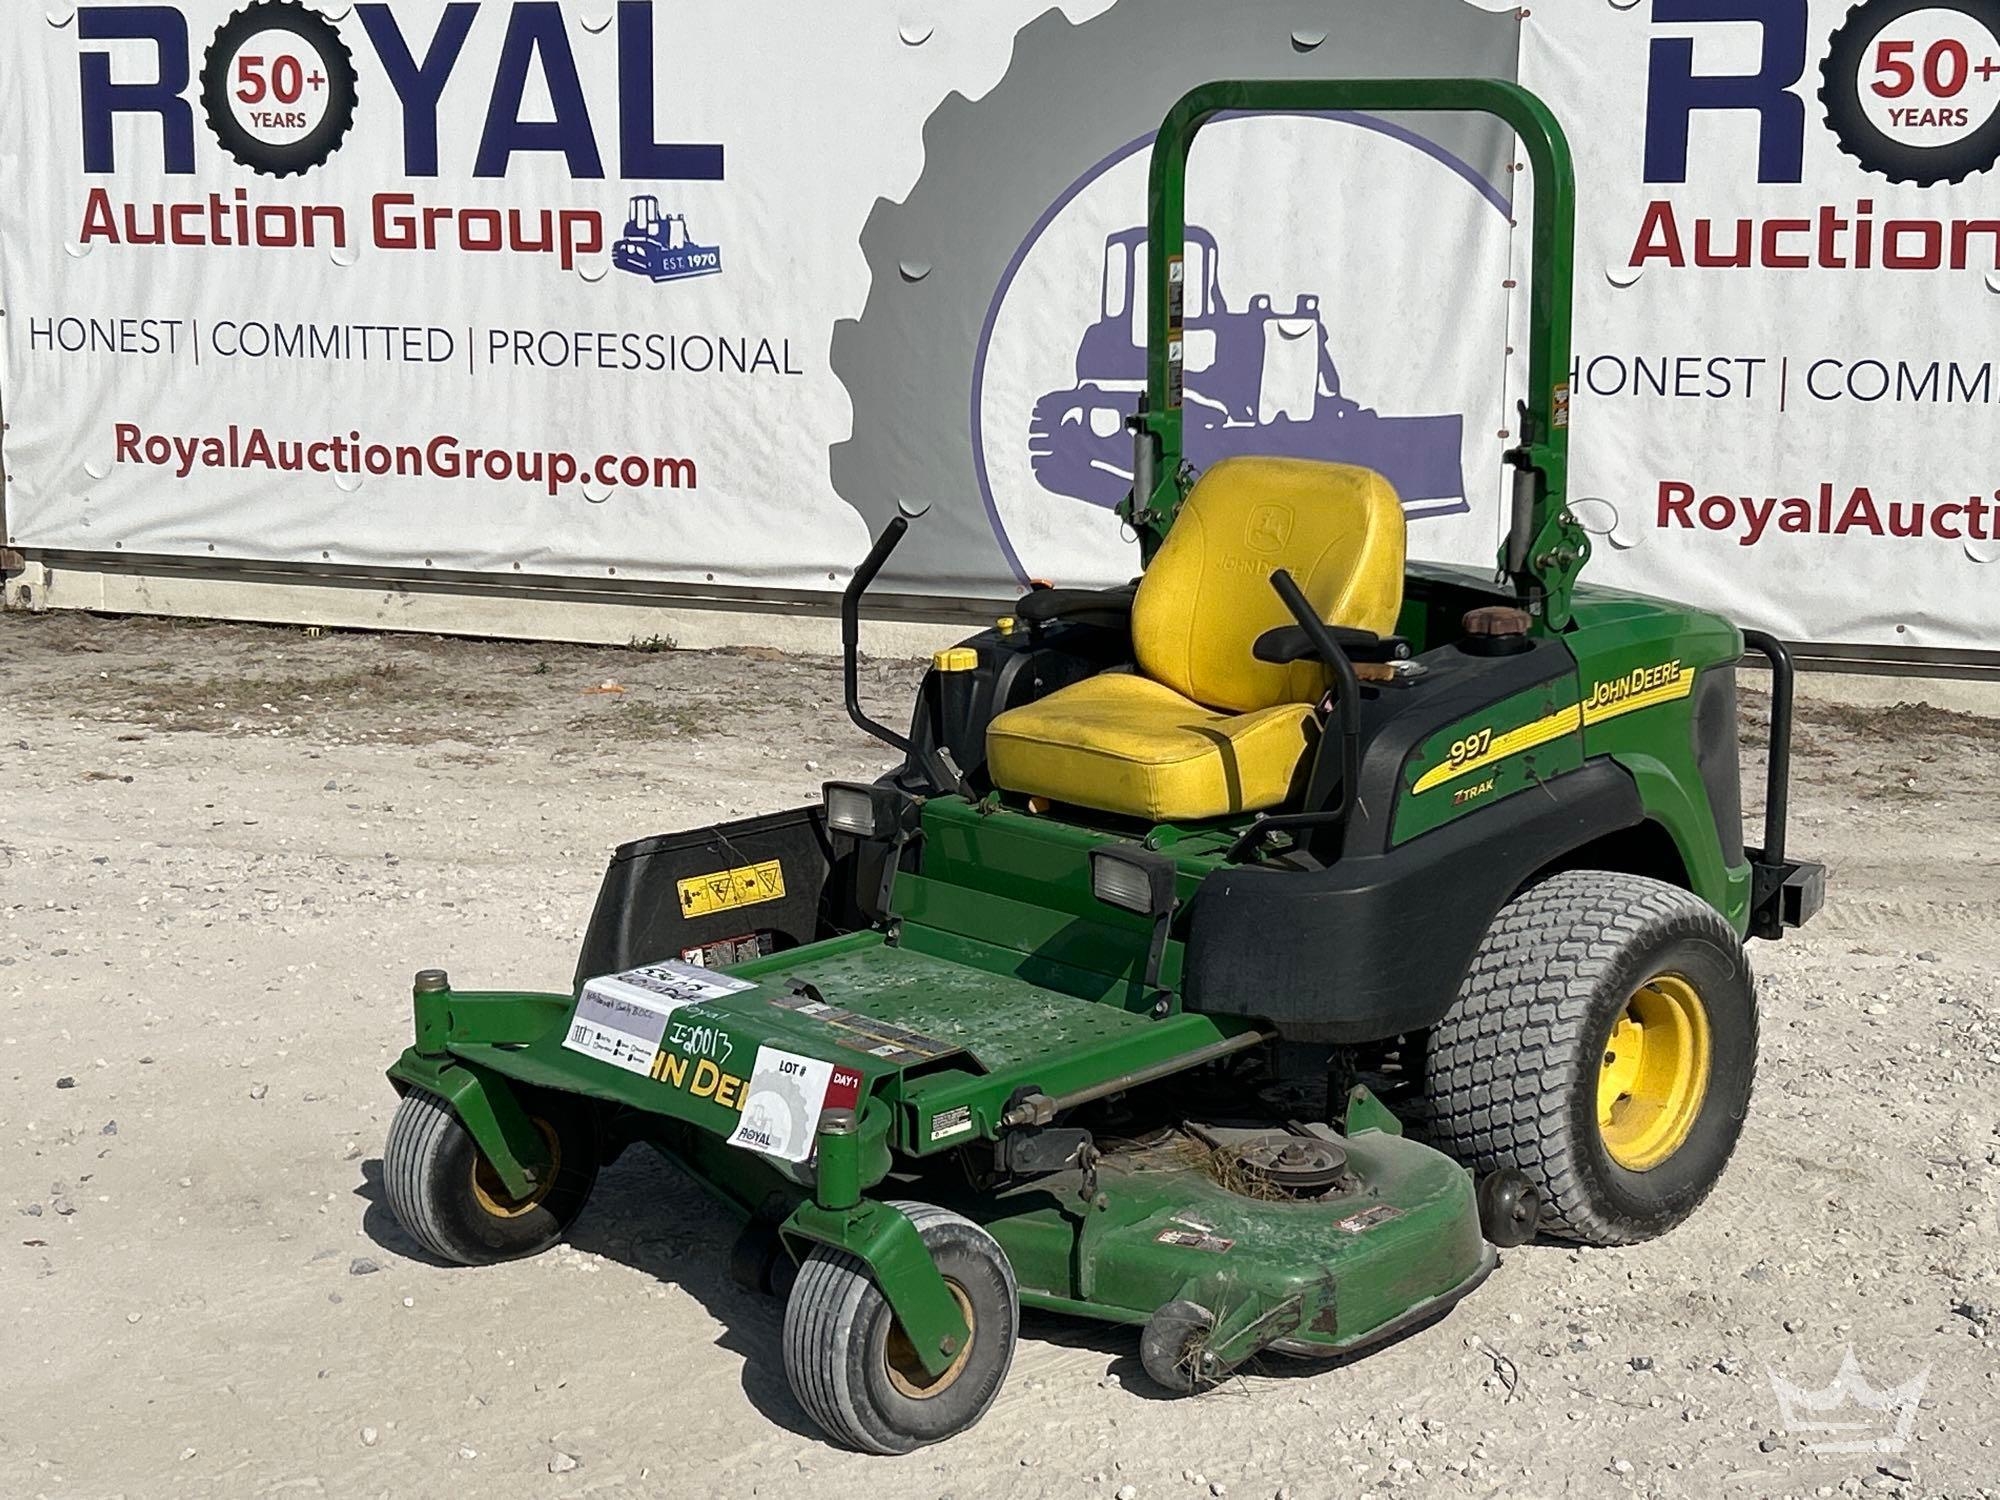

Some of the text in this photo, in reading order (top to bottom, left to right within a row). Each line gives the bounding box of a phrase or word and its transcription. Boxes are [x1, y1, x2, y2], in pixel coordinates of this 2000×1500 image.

[80, 1, 724, 181] ROYAL
[236, 54, 325, 104] 50+
[1870, 38, 2000, 99] 50+
[249, 111, 307, 129] YEARS
[1887, 108, 1969, 127] YEARS
[80, 187, 603, 269] Auction Group
[1629, 199, 2000, 270] Auction
[687, 252, 717, 268] 1970
[29, 316, 804, 375] HONEST COMMITTED PROFESSIONAL
[1806, 359, 2000, 403] COMM
[115, 422, 698, 495] RoyalAuctionGroup.com
[1587, 658, 1681, 709] JOHN DEERE
[1450, 727, 1492, 766] 997
[778, 1060, 799, 1075] LOT
[833, 1073, 853, 1087] DAY
